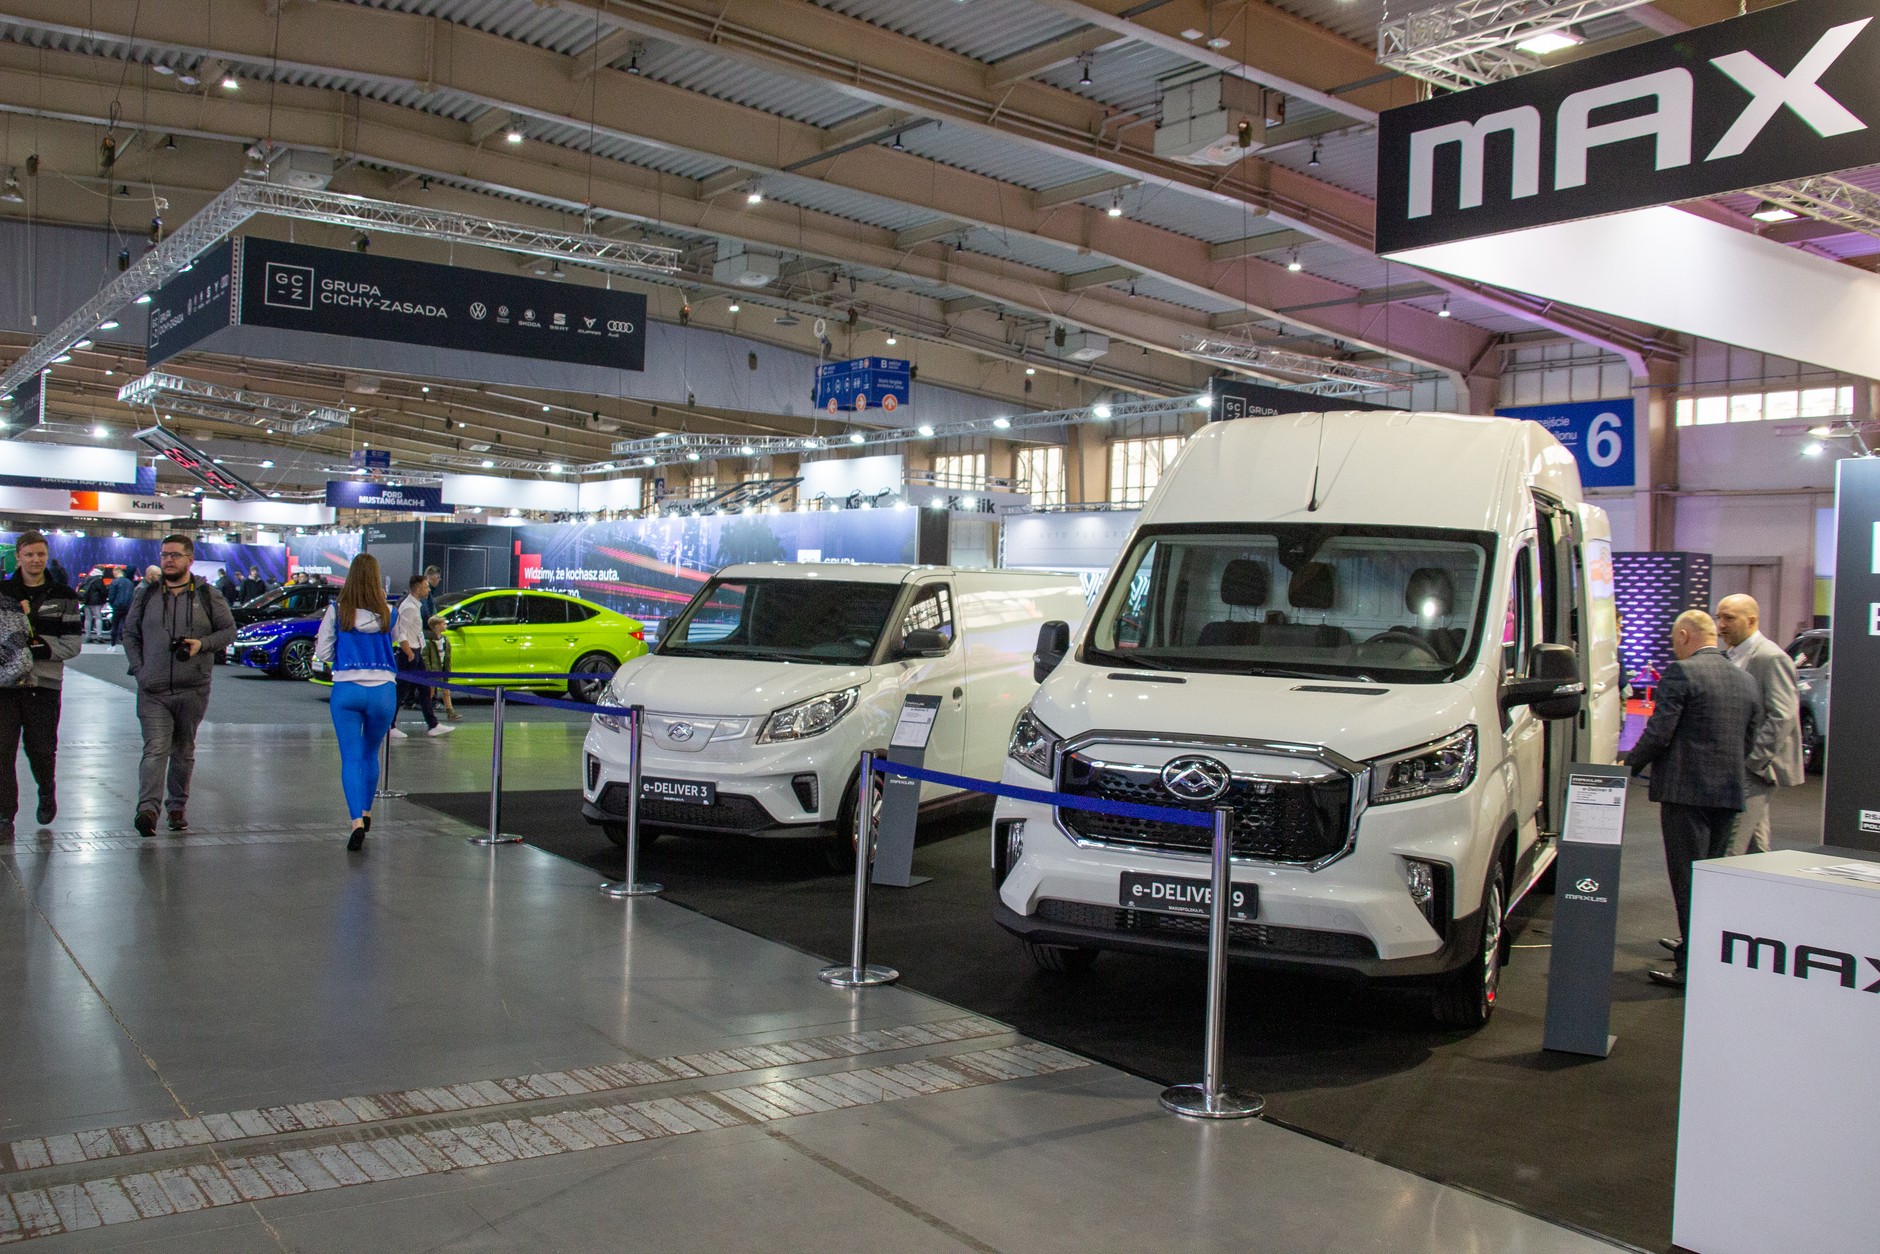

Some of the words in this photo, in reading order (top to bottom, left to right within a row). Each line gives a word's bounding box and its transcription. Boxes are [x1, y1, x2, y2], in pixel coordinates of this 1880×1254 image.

[321, 278, 382, 297] GRUPA
[320, 292, 449, 319] CICHY-ZASADA
[880, 359, 888, 369] B
[1249, 405, 1279, 416] GRUPA
[1586, 411, 1623, 468] 6
[358, 495, 396, 505] MUSTANG
[396, 497, 425, 507] MACH-E
[381, 490, 403, 499] FORD
[132, 500, 165, 511] Karlik
[524, 567, 555, 582] Widzimy,
[555, 567, 564, 580] że
[565, 567, 598, 581] kochasz
[598, 568, 620, 581] auta.
[642, 781, 699, 797] e-DELIVER
[700, 785, 708, 797] 3
[1132, 881, 1212, 904] e-DELIVE
[1232, 890, 1245, 907] 9
[1720, 929, 1880, 994] MA
